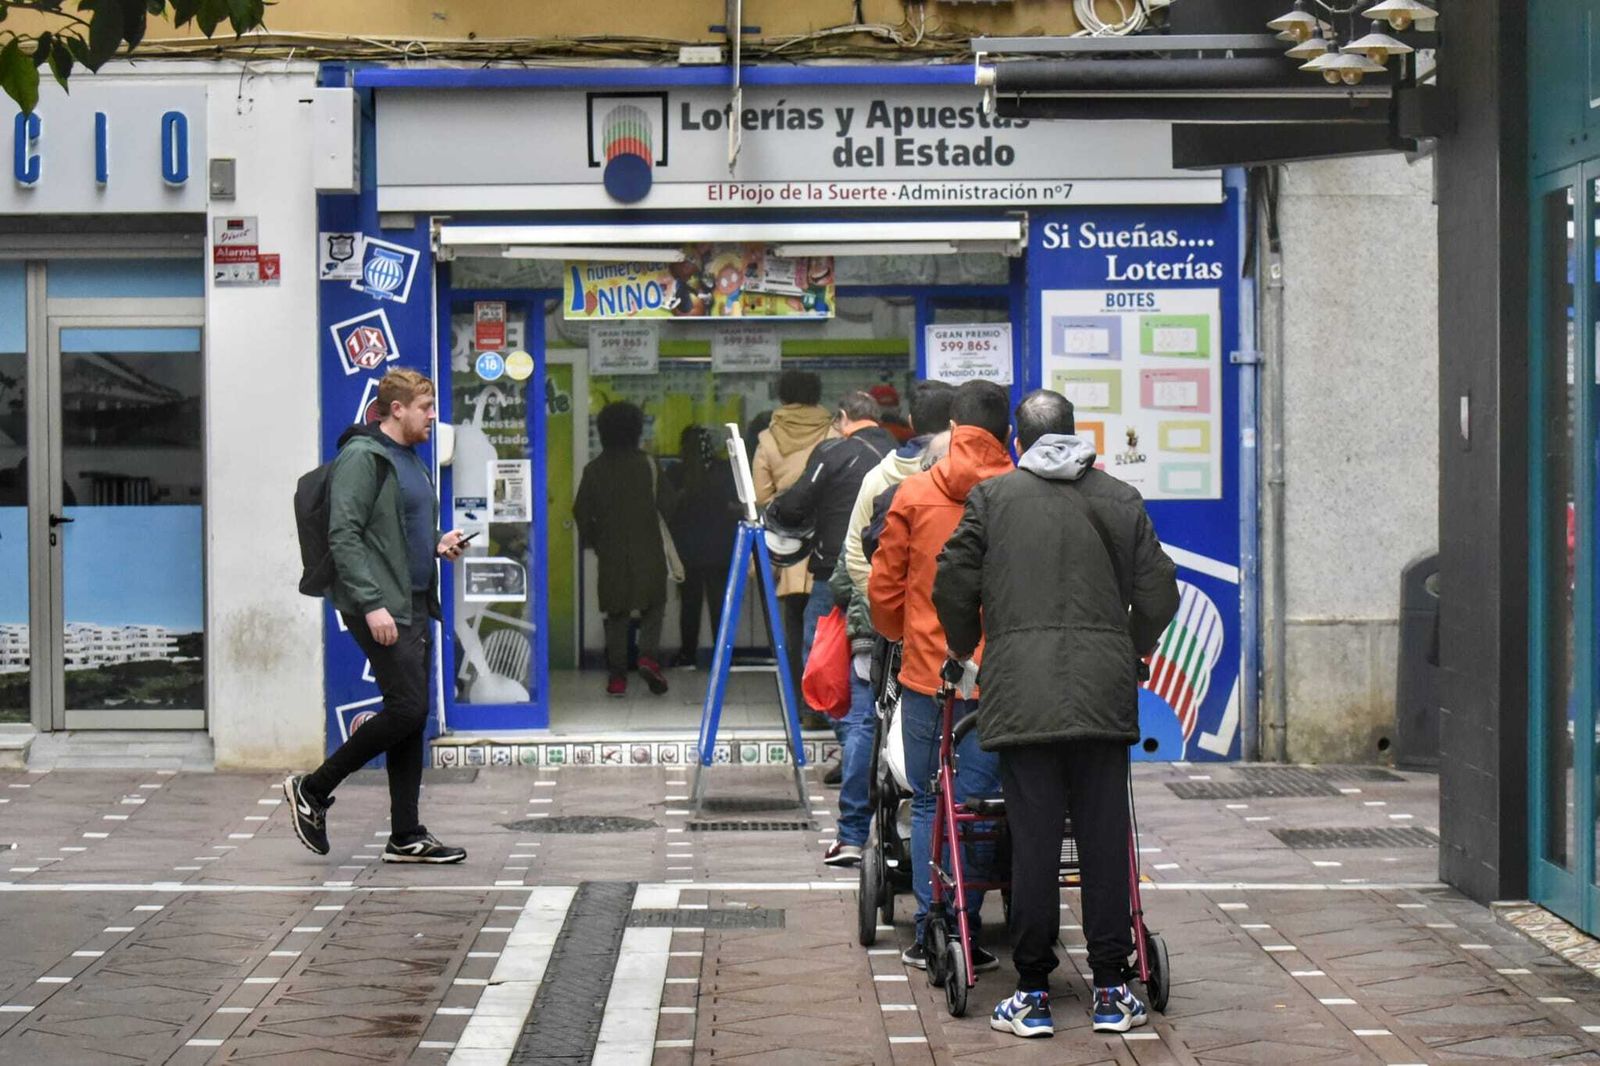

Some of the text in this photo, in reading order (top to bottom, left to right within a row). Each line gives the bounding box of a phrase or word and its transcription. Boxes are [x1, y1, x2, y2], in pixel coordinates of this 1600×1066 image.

[835, 107, 854, 137] y
[833, 137, 1016, 167] del Estado
[708, 185, 723, 200] El
[729, 184, 774, 204] Piojo
[780, 184, 801, 200] de
[808, 184, 822, 200] la
[829, 185, 888, 200] Suerte
[1042, 222, 1070, 249] Si
[216, 248, 257, 257] Alarma
[1105, 254, 1223, 281] Loterías
[598, 276, 662, 316] NIÑO
[1105, 292, 1156, 308] BOTES
[935, 330, 1000, 339] GRAN PREMIO
[939, 369, 975, 377] VENDIDO
[464, 393, 525, 405] Loeas
[462, 418, 525, 429] Auestas
[488, 434, 529, 445] stado
